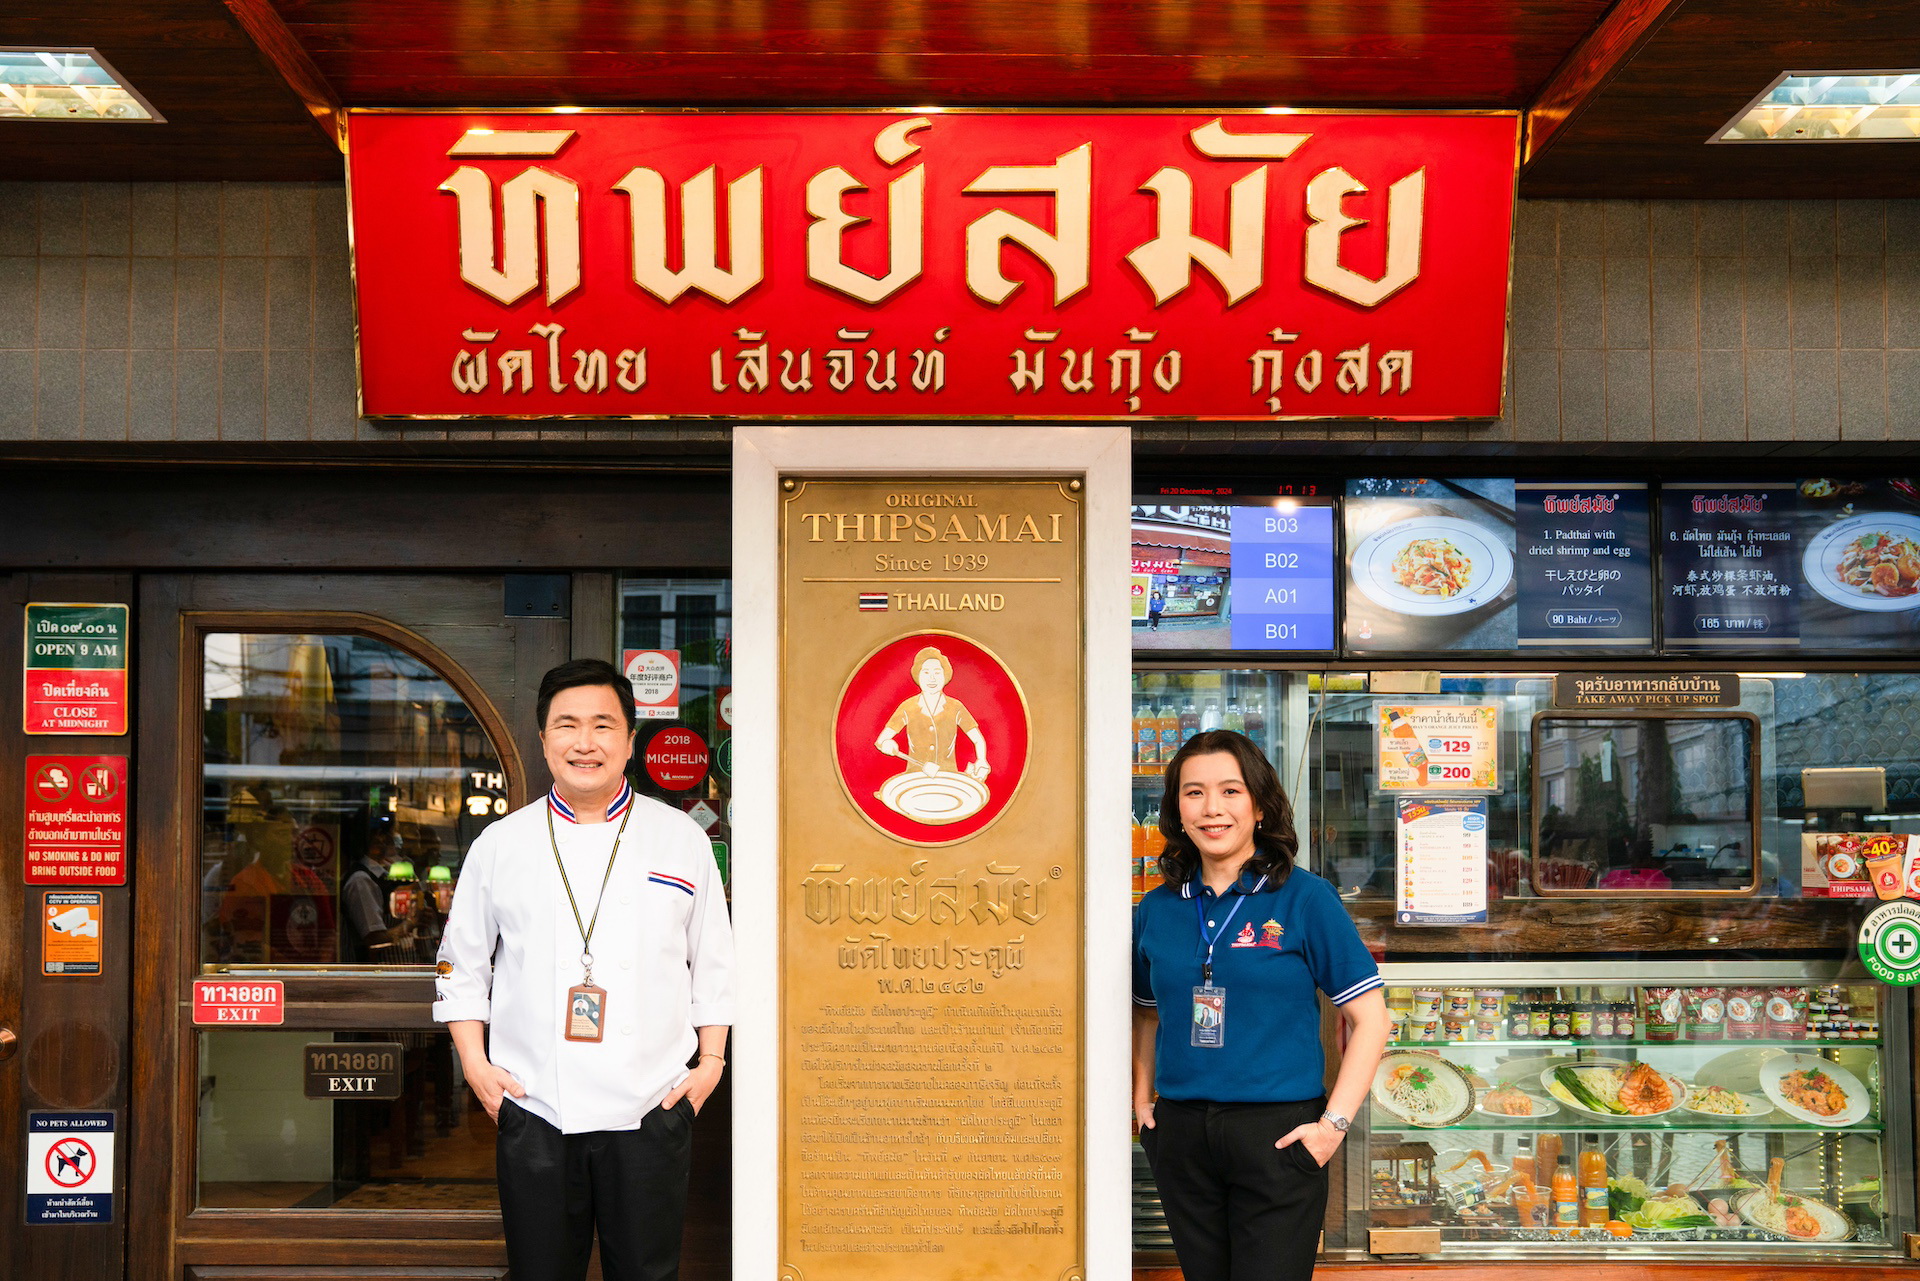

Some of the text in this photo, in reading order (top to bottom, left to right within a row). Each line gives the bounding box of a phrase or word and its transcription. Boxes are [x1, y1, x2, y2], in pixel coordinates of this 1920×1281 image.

[438, 115, 1427, 308] ทิพย์สมัย
[450, 323, 1413, 411] ผัดไทย เส้นจันท์ มันกุ้ง กุ้งสด
[885, 494, 978, 507] ORIGINAL
[801, 513, 1063, 543] THIPSAMAI
[1265, 518, 1298, 533] B03
[1544, 530, 1615, 540] 1. Padthai with
[1670, 528, 1790, 544] 6. ผัดไทย มันกุ้ง กุ้งทะเลสด
[1529, 546, 1631, 558] dried shrimp and egg
[1698, 545, 1762, 558] ไม่ใส่เส้น ใส่ไข่
[875, 554, 988, 572] Since 1939
[1265, 554, 1298, 568] B02
[1545, 570, 1621, 582] 干しえびと卵の
[1264, 589, 1297, 604] A01
[1562, 585, 1604, 596] パッタイ
[1742, 585, 1792, 596] 不放河粉
[893, 593, 1005, 612] THAILAND
[1552, 614, 1564, 624] 90
[1701, 619, 1720, 628] 165
[37, 620, 58, 633] เปิด
[108, 624, 117, 634] น
[1265, 624, 1297, 639] B01
[35, 644, 117, 656] OPEN 9 AM
[42, 680, 110, 697] ปิดเที่ยงคืน
[1576, 676, 1720, 695] จุดรับอาหารกลับบ้าน
[1576, 695, 1720, 704] TAKE AWAY PICK UP SPOT
[54, 707, 97, 718] CLOSE
[1410, 710, 1478, 723] ราคาน้ำส้มวันนี้
[58, 720, 109, 728] MIDNIGHT
[664, 736, 690, 744] 2018
[1443, 741, 1470, 752] 129
[647, 754, 708, 764] MICHELIN
[1443, 768, 1470, 778] 200
[28, 808, 121, 826] ห้ามสูบบุหรี่และนำอาหาร
[1871, 841, 1890, 856] 40
[28, 851, 120, 862] NO SMOKING & DO NOT
[32, 866, 116, 876] BRING OUTSIDE FOOD
[838, 931, 1025, 978] ผัดไทยประตูผี
[1867, 956, 1920, 982] FOOD SAF
[878, 976, 986, 993] พ.ศ.๒๔๘๒
[201, 986, 276, 1002] ทางออก
[217, 1008, 260, 1021] EXIT
[311, 1053, 394, 1070] ทางออก
[328, 1078, 376, 1092] EXIT
[47, 1196, 93, 1206] ห้ามนำสัตว์เลี้ยง
[42, 1210, 98, 1218] เข้ามาในบริเวณร้าน
